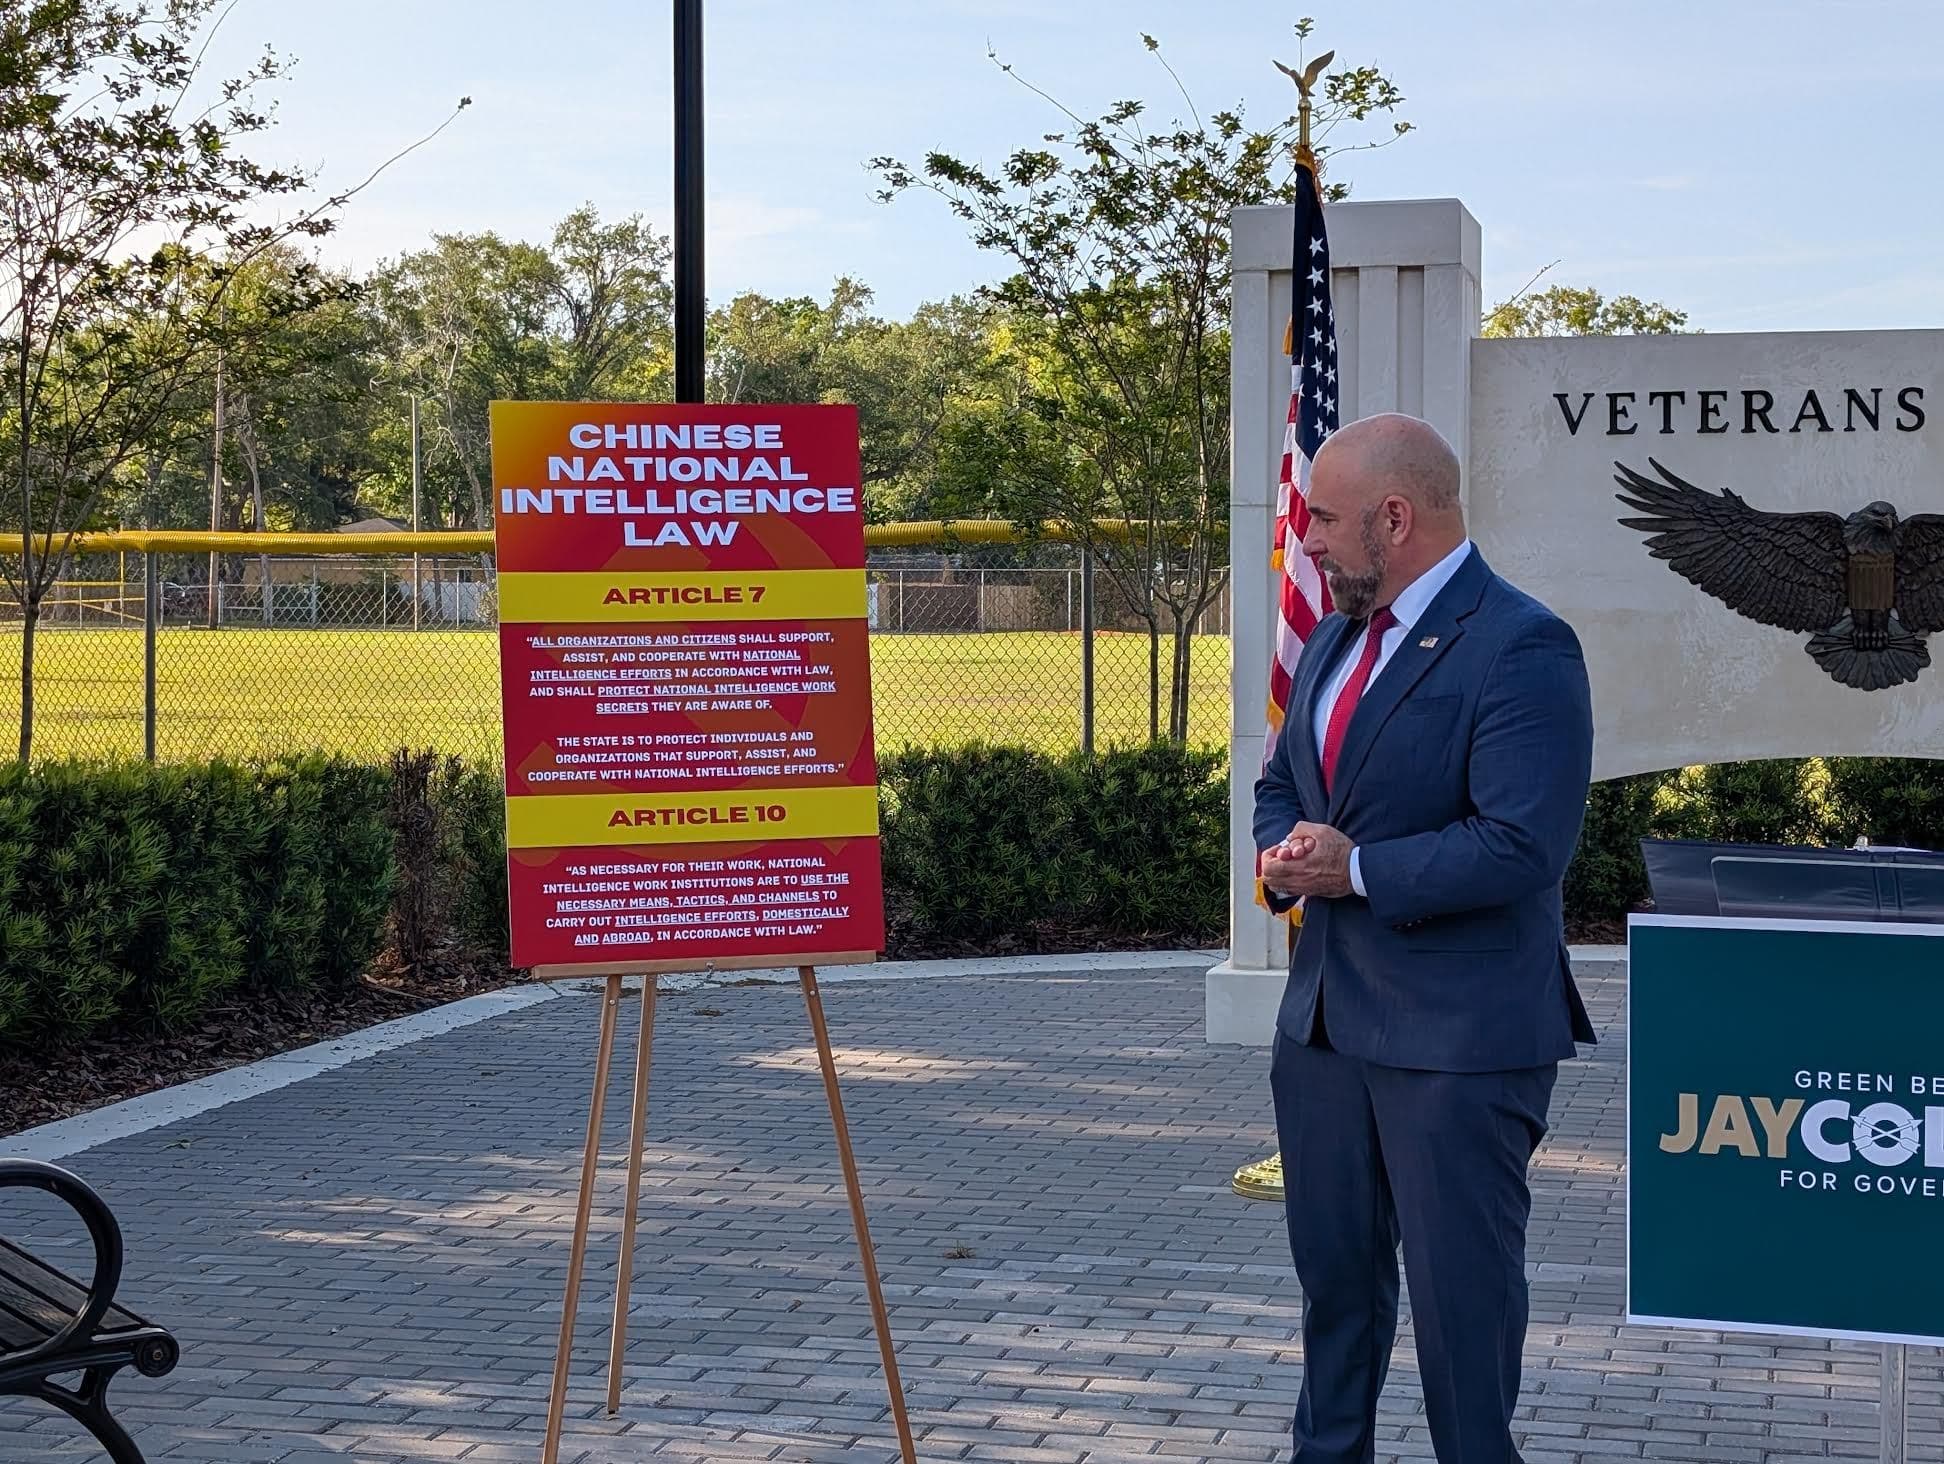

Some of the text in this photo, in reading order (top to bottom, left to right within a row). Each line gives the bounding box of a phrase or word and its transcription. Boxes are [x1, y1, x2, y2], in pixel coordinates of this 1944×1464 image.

[1553, 387, 1925, 436] VETERANS
[569, 424, 783, 450] CHINESE
[548, 456, 809, 481] NATIONAL
[501, 487, 856, 514] INTELLIGENCE
[624, 521, 739, 546] LAW
[603, 586, 766, 604] ARTICLE 7
[557, 635, 652, 646] ORGANIZATIONS
[655, 635, 679, 645] AND
[682, 634, 736, 645] CITIZENS
[739, 634, 776, 643] SHALL
[779, 633, 834, 643] SUPPORT,
[563, 650, 801, 663] ASSIST, AND COOPERATE WITH NATIONAL
[530, 666, 833, 680] INTELLIGENCE EFFORTS IN ACCORDANCE WITH LAW,
[529, 682, 836, 697] AND SHALL PROTECT NATIONAL INTELLIGENCE WORK
[596, 700, 772, 713] SECRETS THEY ARE AWARE OF.
[557, 732, 813, 747] THE STATE IS TO PROTECT INDIVIDUALS AND
[556, 748, 816, 764] ORGANIZATIONS THAT SUPPORT, ASSIST, AND
[528, 771, 597, 781] COOPERATE
[600, 769, 631, 779] WITH
[634, 768, 693, 779] NATIONAL
[696, 766, 781, 777] INTELLIGENCE
[608, 805, 786, 827] ARTICLE 10
[590, 864, 659, 874] NECESSARY
[662, 863, 685, 872] FOR
[688, 861, 724, 872] THEIR
[727, 860, 765, 870] WORK,
[768, 858, 825, 869] NATIONAL
[543, 873, 849, 893] INTELLIGENCE WORK INSTITUTIONS ARE TO USE THE
[556, 891, 837, 911] NECESSARY MEANS, TACTICS, AND CHANNELS TO
[546, 907, 849, 928] CARRY OUT INTELLIGENCE EFFORTS, DOMESTICALLY
[574, 934, 599, 945] AND
[602, 932, 653, 944] ABROAD,
[657, 931, 671, 941] IN
[674, 928, 751, 940] ACCORDANCE
[755, 926, 785, 936] WITH
[1795, 1071, 1893, 1092] GREEN
[1780, 1170, 1944, 1196] FOR GOVE
